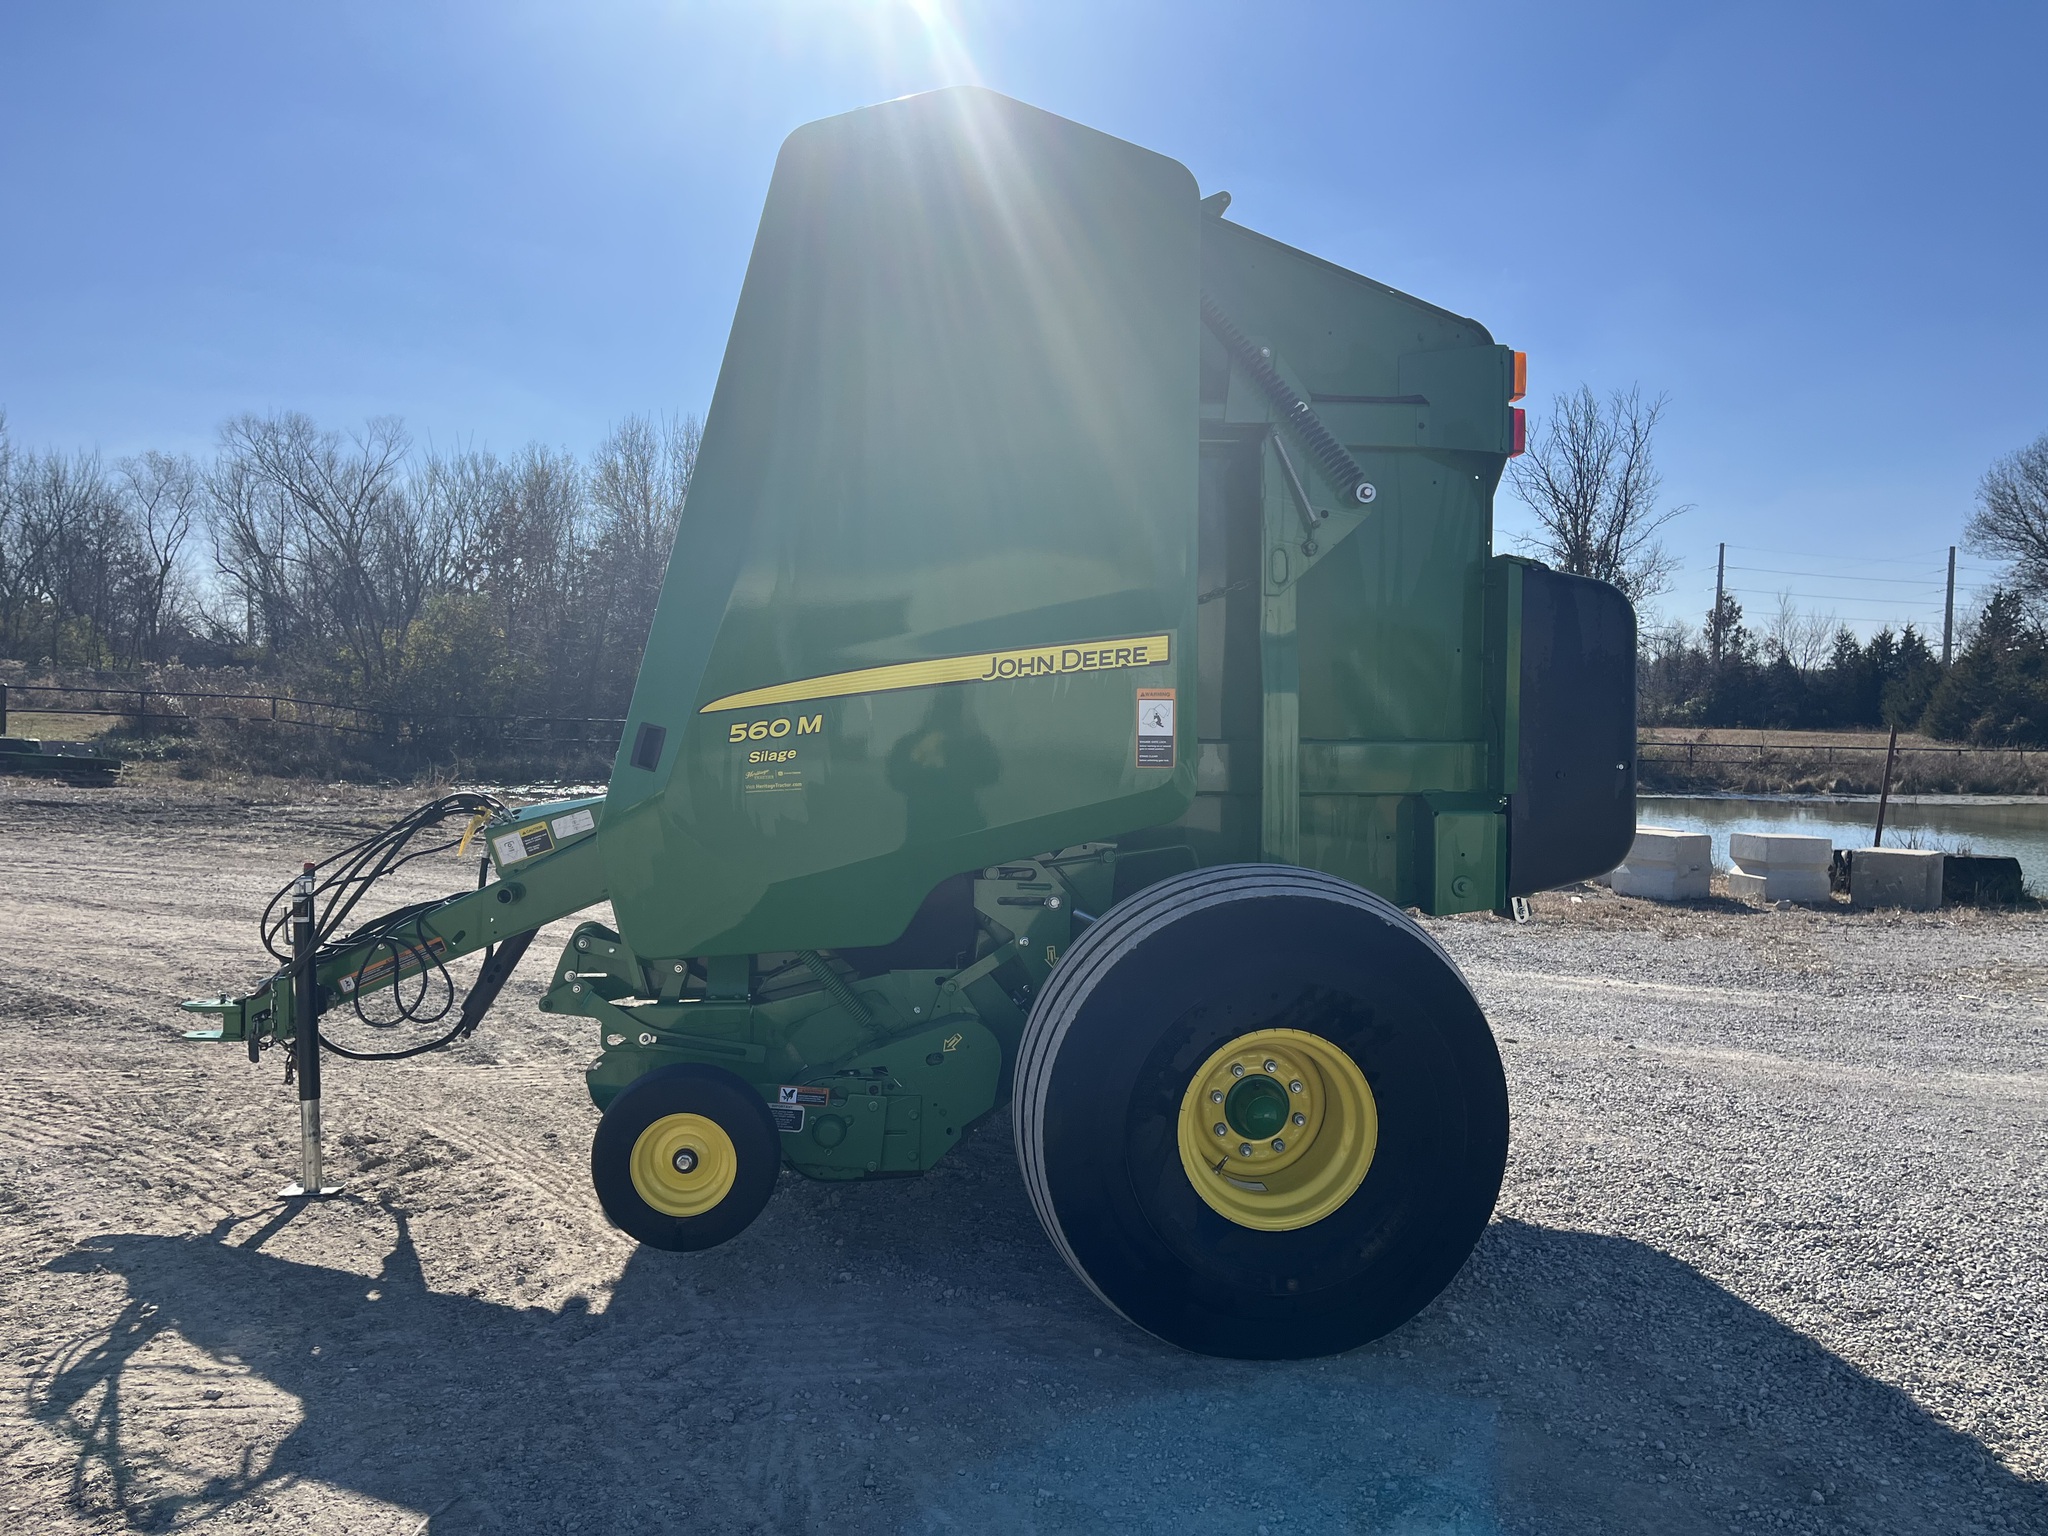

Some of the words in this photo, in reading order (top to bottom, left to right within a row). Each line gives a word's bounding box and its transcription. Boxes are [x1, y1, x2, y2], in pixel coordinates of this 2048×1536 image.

[981, 655, 1055, 679] JOHN
[1061, 646, 1148, 670] DEERE
[729, 718, 791, 742] 560
[796, 714, 823, 735] M
[748, 749, 797, 763] Silage
